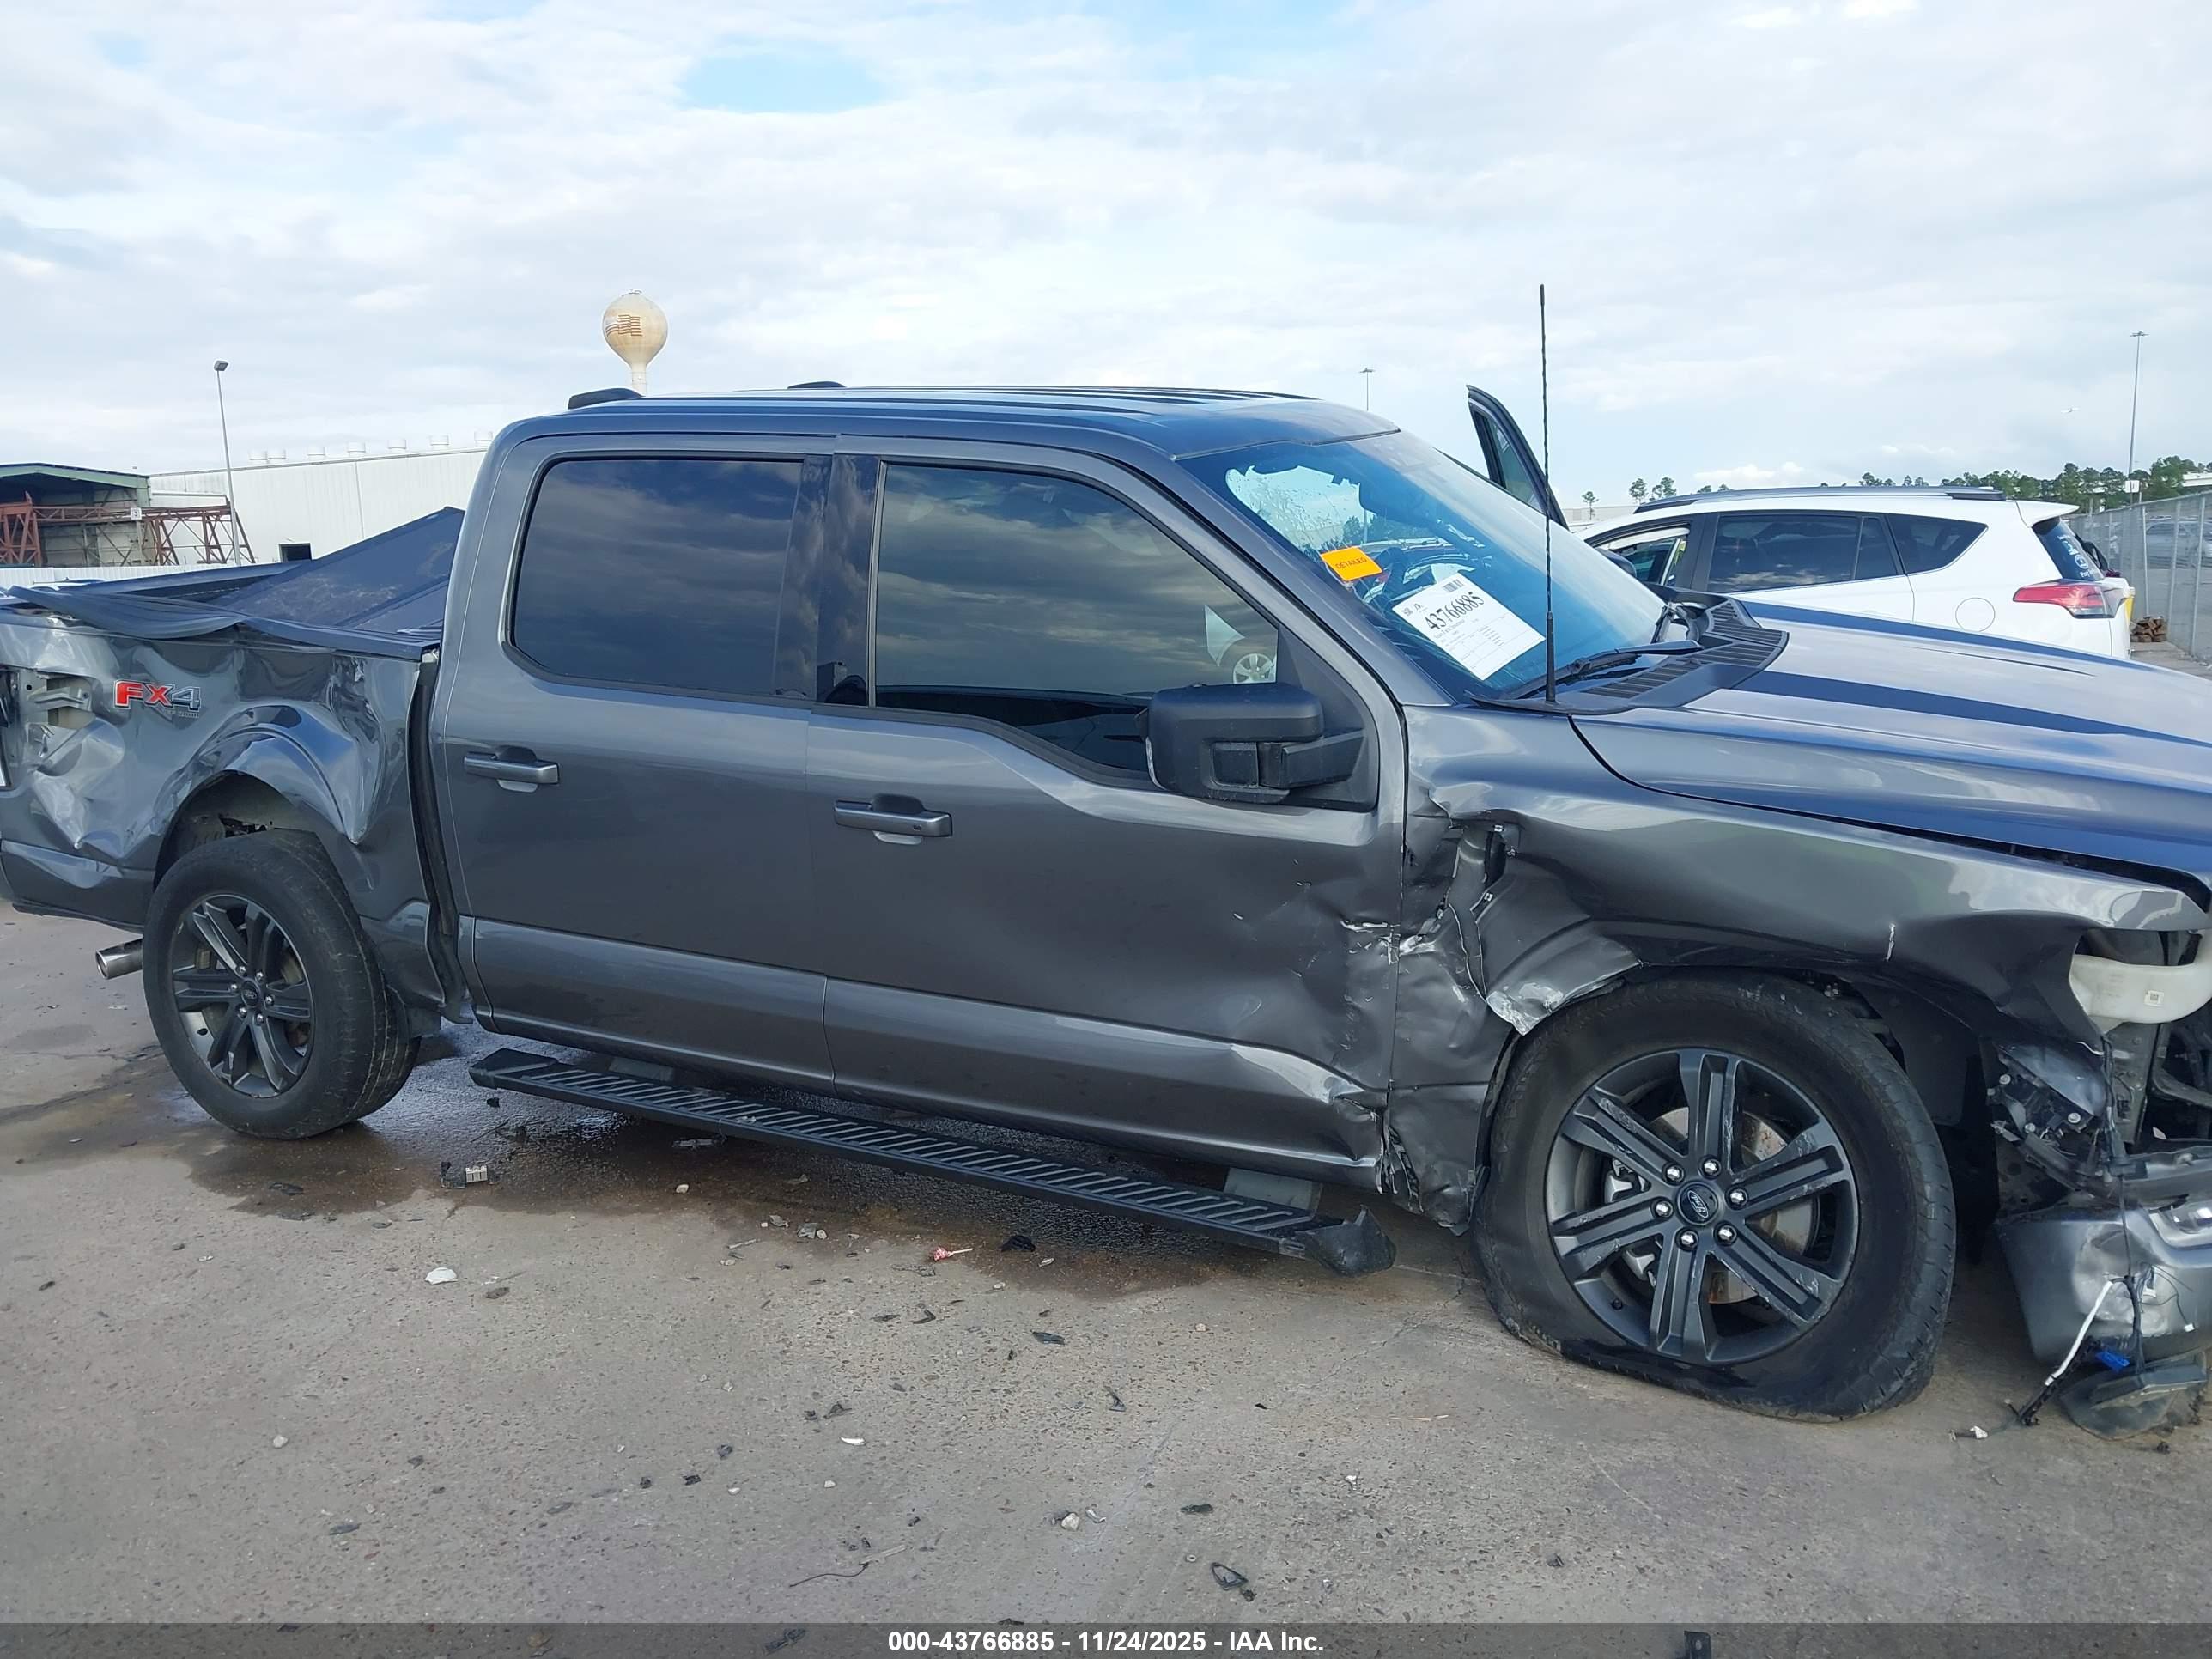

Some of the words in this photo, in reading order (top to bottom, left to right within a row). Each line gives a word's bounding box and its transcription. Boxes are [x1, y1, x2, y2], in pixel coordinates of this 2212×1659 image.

[1334, 556, 1367, 569] DETAILED
[1425, 591, 1485, 630] 43766885
[113, 680, 201, 712] FX4
